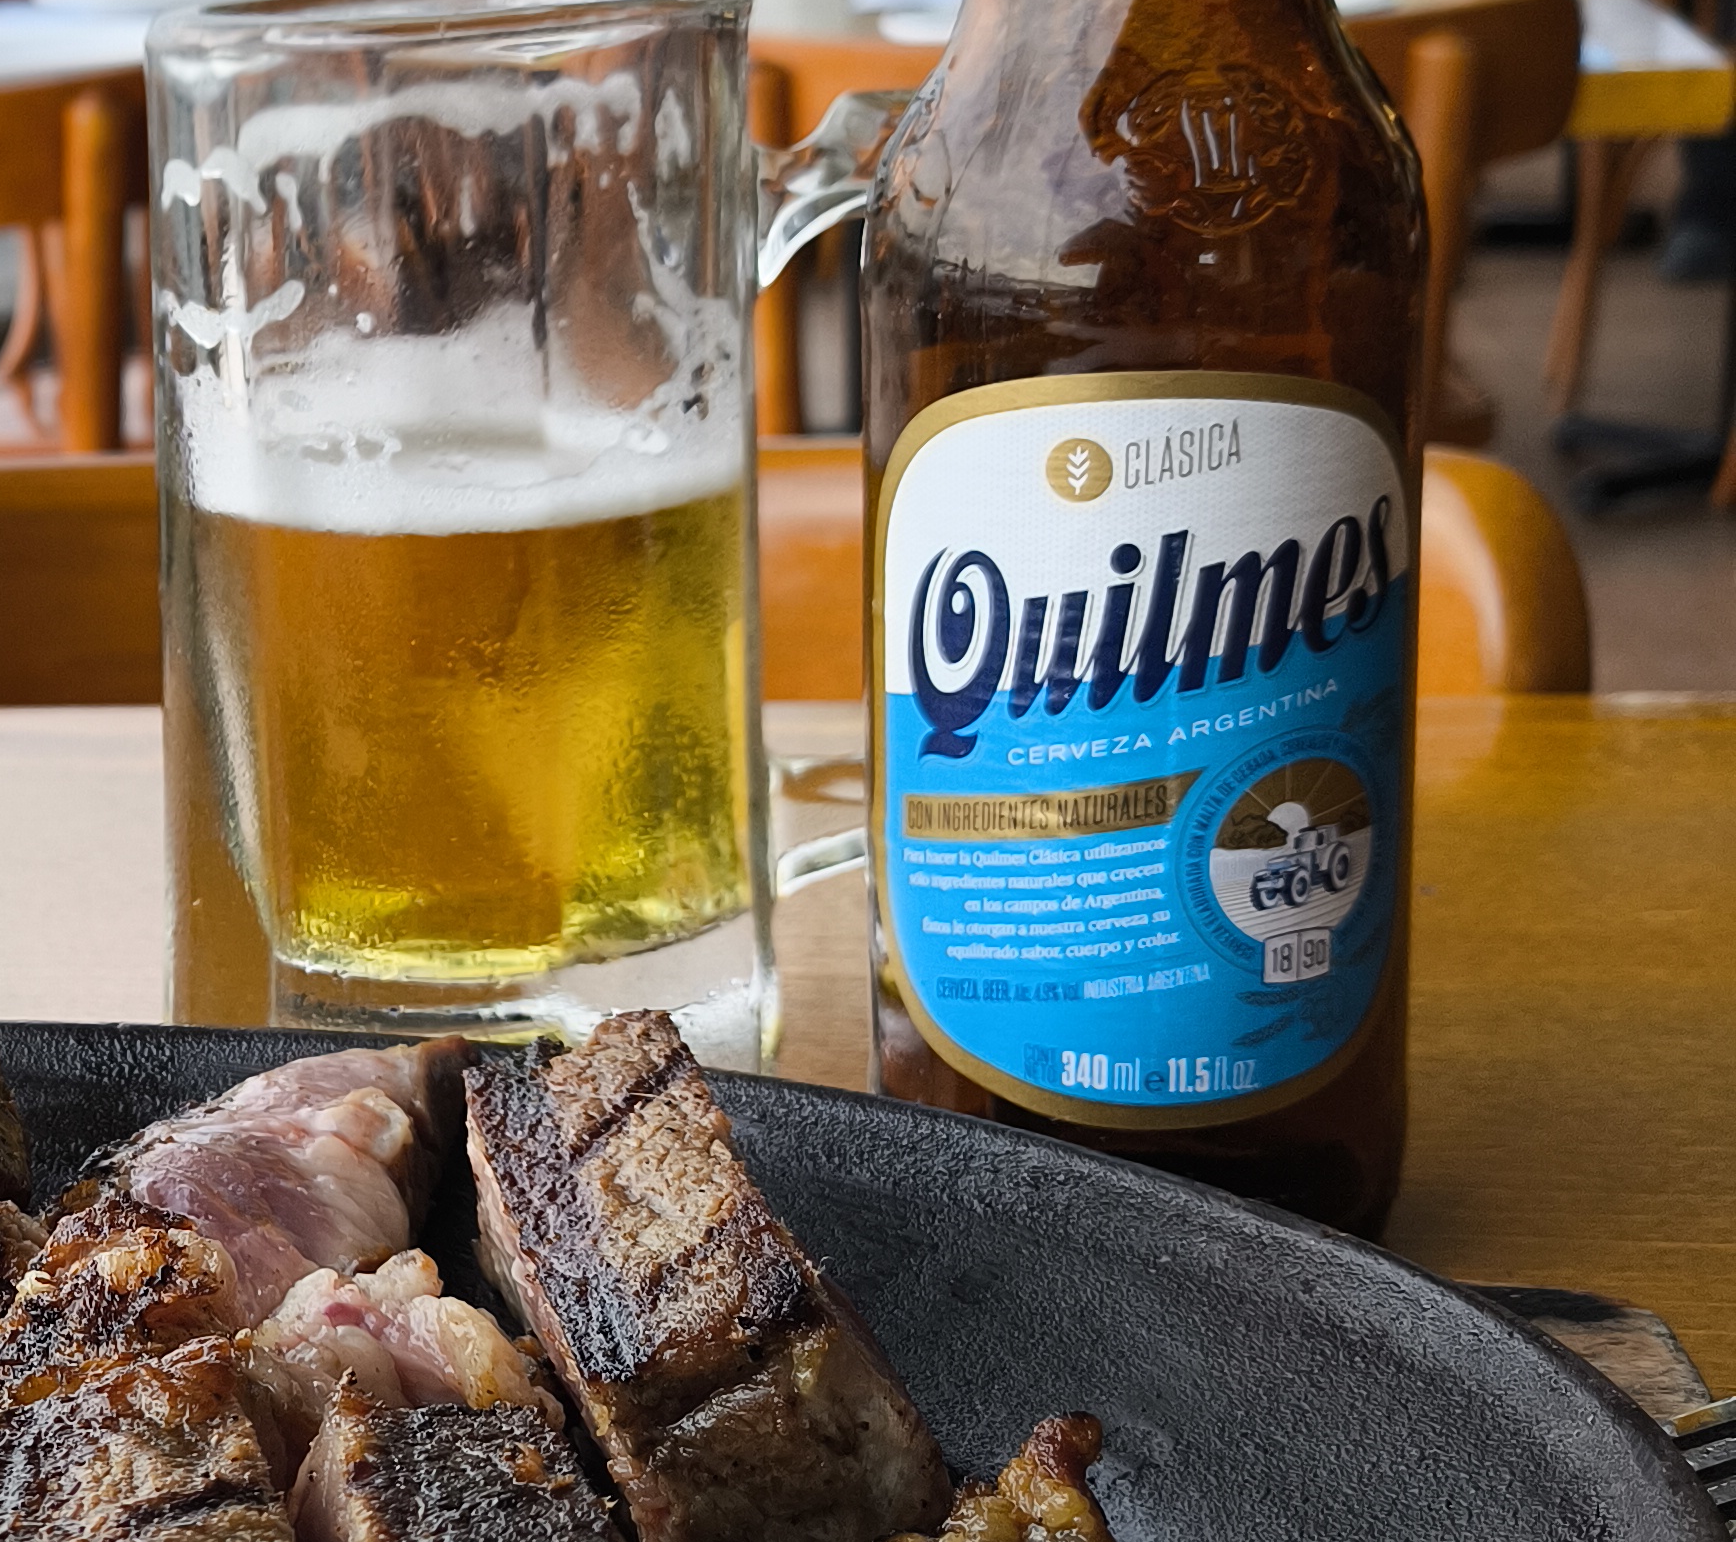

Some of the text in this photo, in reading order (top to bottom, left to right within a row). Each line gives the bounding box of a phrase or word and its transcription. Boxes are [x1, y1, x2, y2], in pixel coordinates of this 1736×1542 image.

[1124, 418, 1242, 490] CLÁSICA
[909, 495, 1389, 757] Quilmes
[1006, 731, 1152, 767] CERVEZA
[1167, 677, 1340, 746] ARGENTINA
[907, 784, 1166, 832] CON INGREDIENTES NATURALES
[972, 850, 1028, 869] Quilmes
[1029, 847, 1082, 866] Clásica
[1084, 838, 1166, 861] utilizamos
[931, 873, 1006, 892] ingredientes
[1007, 871, 1074, 890] naturales
[1076, 870, 1107, 888] que
[1109, 862, 1165, 881] crecen
[1003, 900, 1058, 916] campos
[1060, 894, 1082, 911] de
[1016, 924, 1028, 936] a
[1028, 919, 1085, 936] nuestra
[1087, 912, 1149, 932] cerveza
[945, 941, 1019, 961] equilibrado
[1065, 939, 1122, 959] cuerpo
[1124, 938, 1135, 954] y
[1270, 938, 1327, 974] 18 90
[1061, 1050, 1108, 1090] 340
[1114, 1056, 1141, 1093] ml
[1168, 1056, 1211, 1093] 11.5
